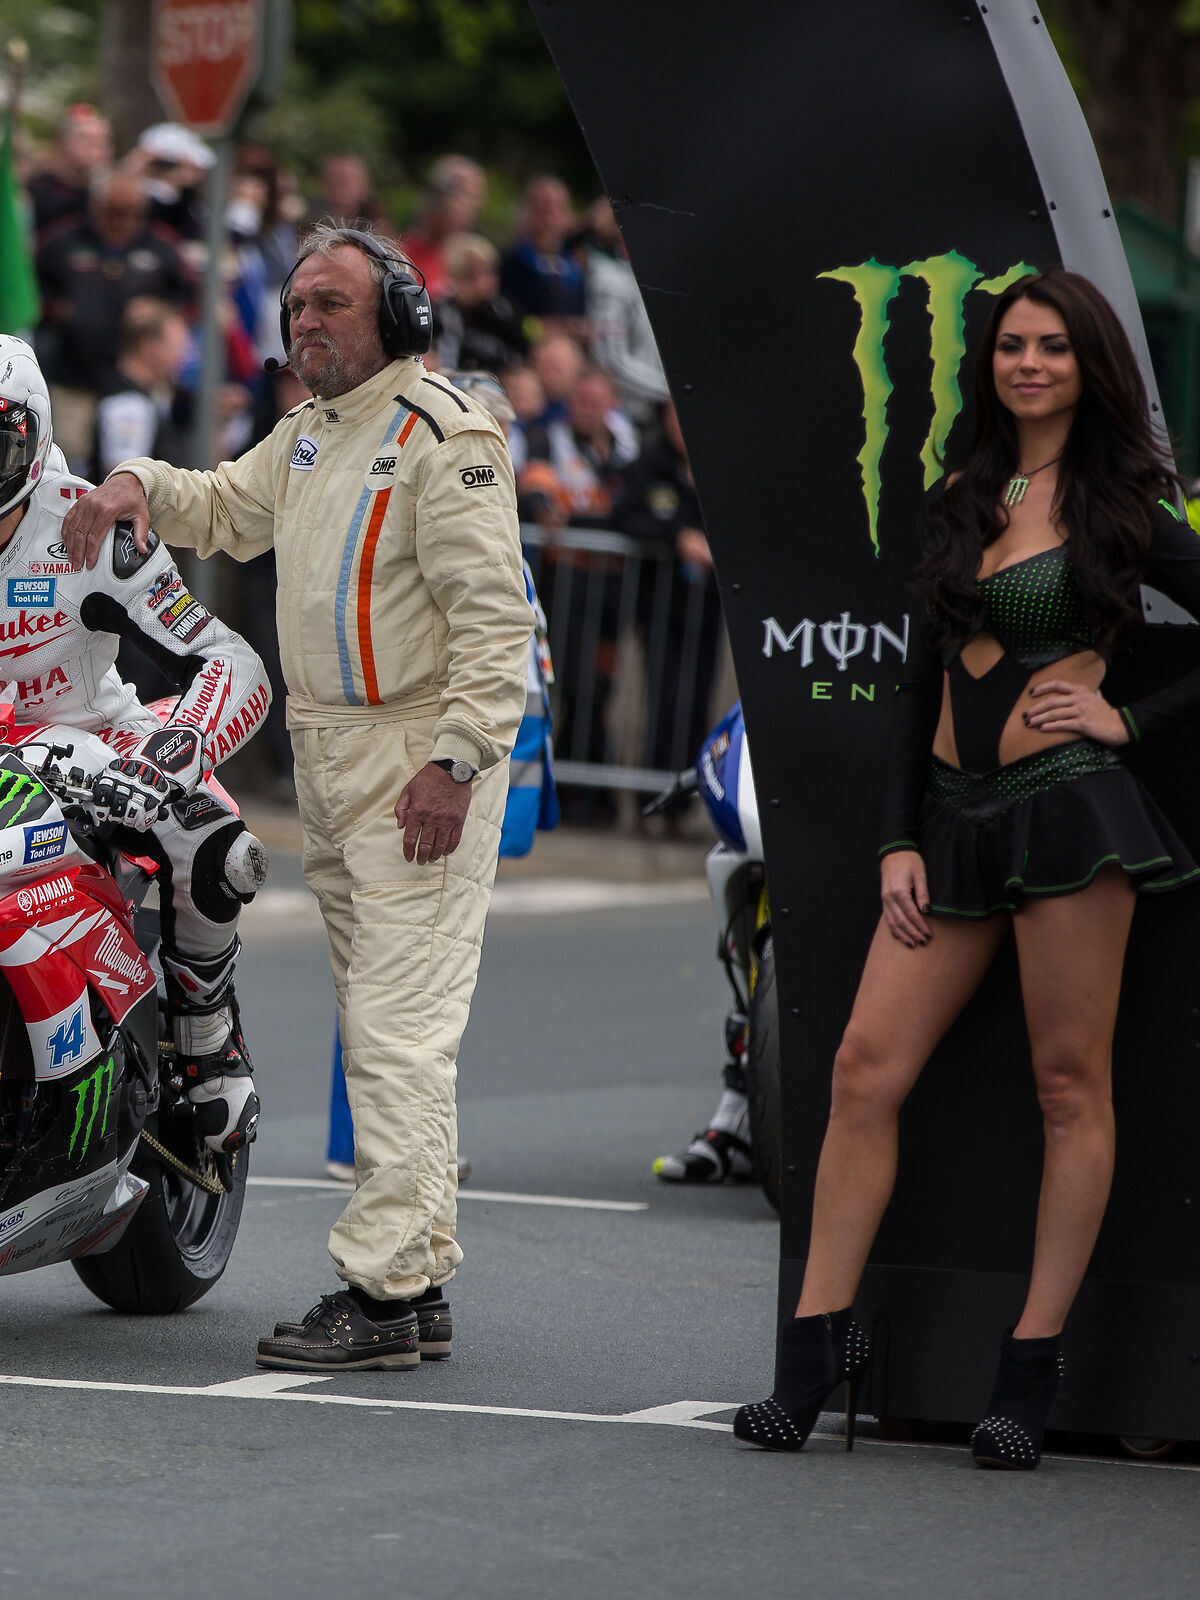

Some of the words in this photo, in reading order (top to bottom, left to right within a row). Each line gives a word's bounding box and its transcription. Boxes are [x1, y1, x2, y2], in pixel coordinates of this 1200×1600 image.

[371, 459, 396, 472] OMP
[461, 469, 496, 486] OMP
[42, 562, 82, 574] YAMA
[13, 580, 50, 591] JEWSON
[13, 595, 31, 603] Tool
[32, 594, 49, 603] Hire
[812, 682, 896, 702] EN
[204, 684, 268, 766] YAMAHA
[155, 731, 184, 761] RST
[31, 825, 66, 844] JEWSON
[29, 847, 46, 860] Tool
[46, 844, 62, 856] Hire
[29, 875, 74, 906] YAMAHA
[26, 895, 75, 918] RACING
[94, 920, 148, 986] Milwaukee
[46, 1004, 87, 1069] 14
